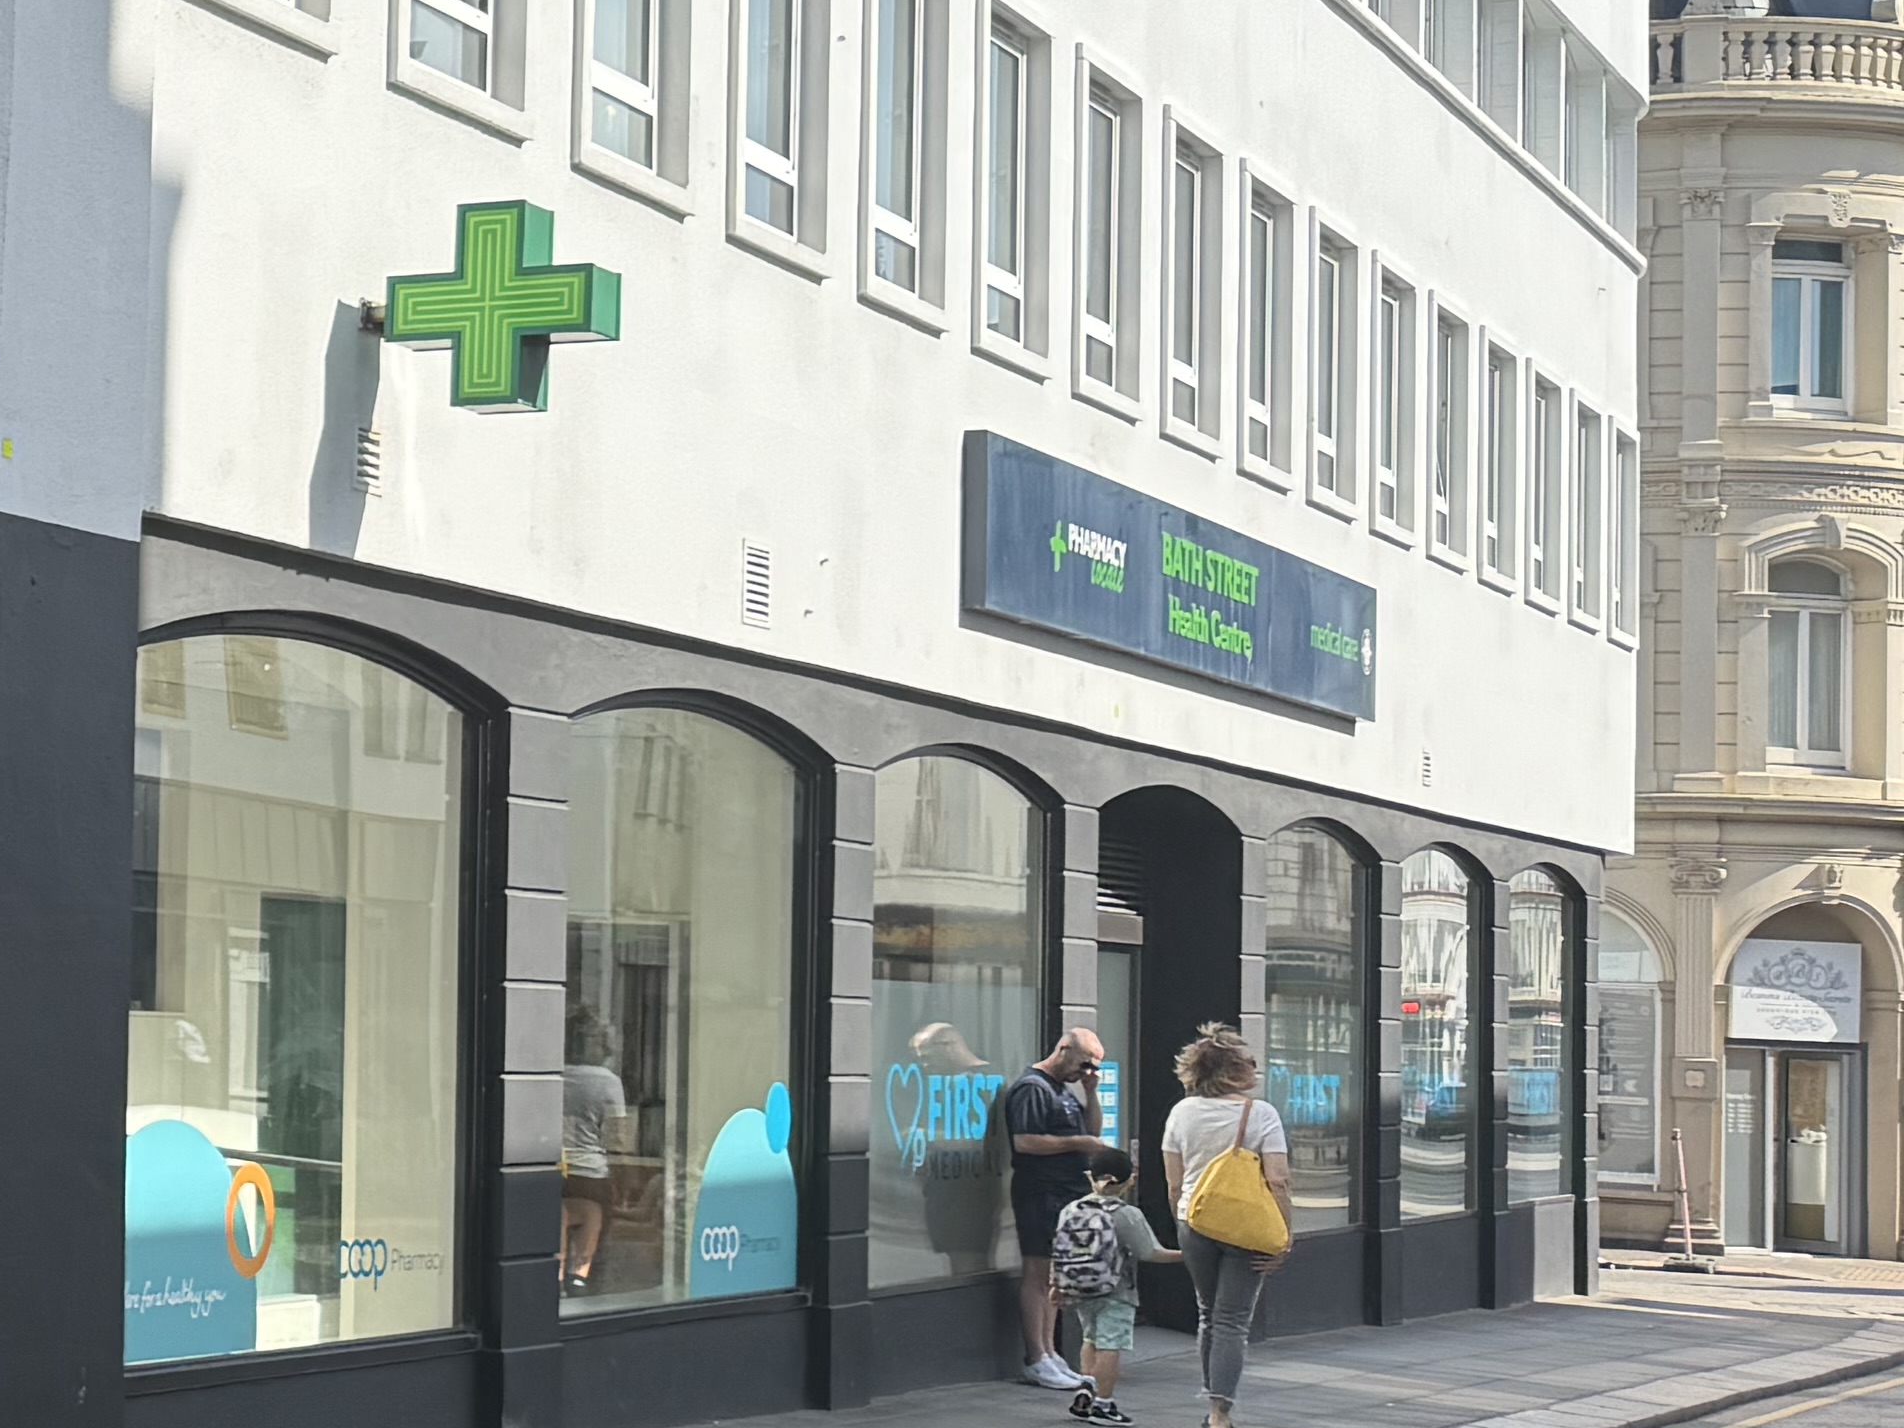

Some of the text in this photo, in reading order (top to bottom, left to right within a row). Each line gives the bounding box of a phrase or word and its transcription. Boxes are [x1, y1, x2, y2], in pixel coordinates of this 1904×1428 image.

[1068, 523, 1127, 569] PHARMACY
[1162, 531, 1259, 606] BATH STREET
[1168, 592, 1253, 660] Health Centre
[928, 1073, 1006, 1142] FIRST
[337, 1238, 444, 1292] coop Pharmacy
[701, 1225, 740, 1272] coop
